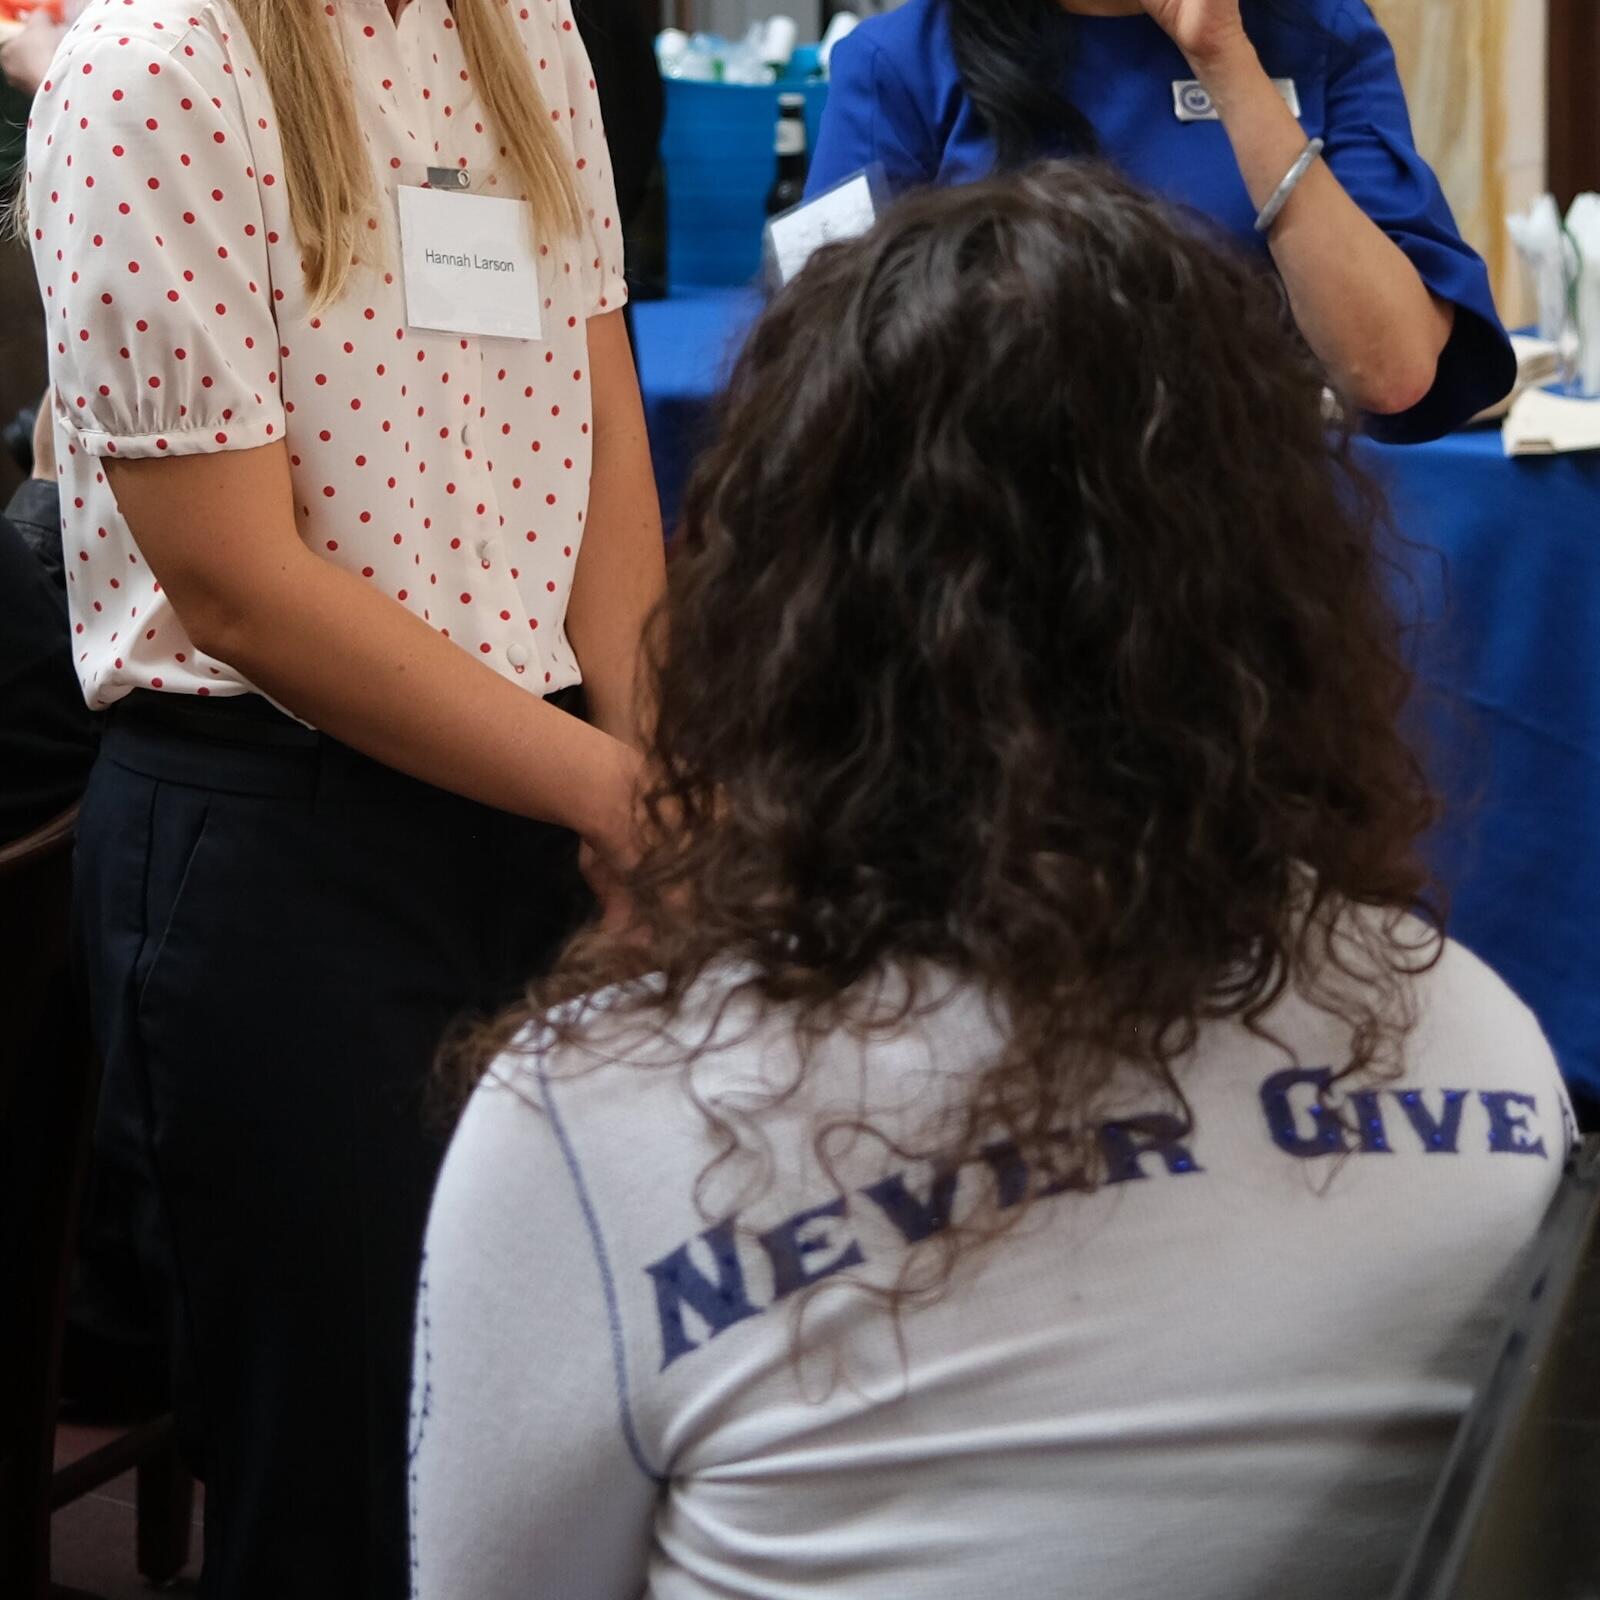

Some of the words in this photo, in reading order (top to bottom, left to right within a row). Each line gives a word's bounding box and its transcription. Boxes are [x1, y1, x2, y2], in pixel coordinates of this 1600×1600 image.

[425, 249, 471, 268] Hannah
[474, 254, 515, 273] Larson
[643, 1111, 1206, 1374] NEVER
[1260, 1066, 1548, 1160] GIVE
